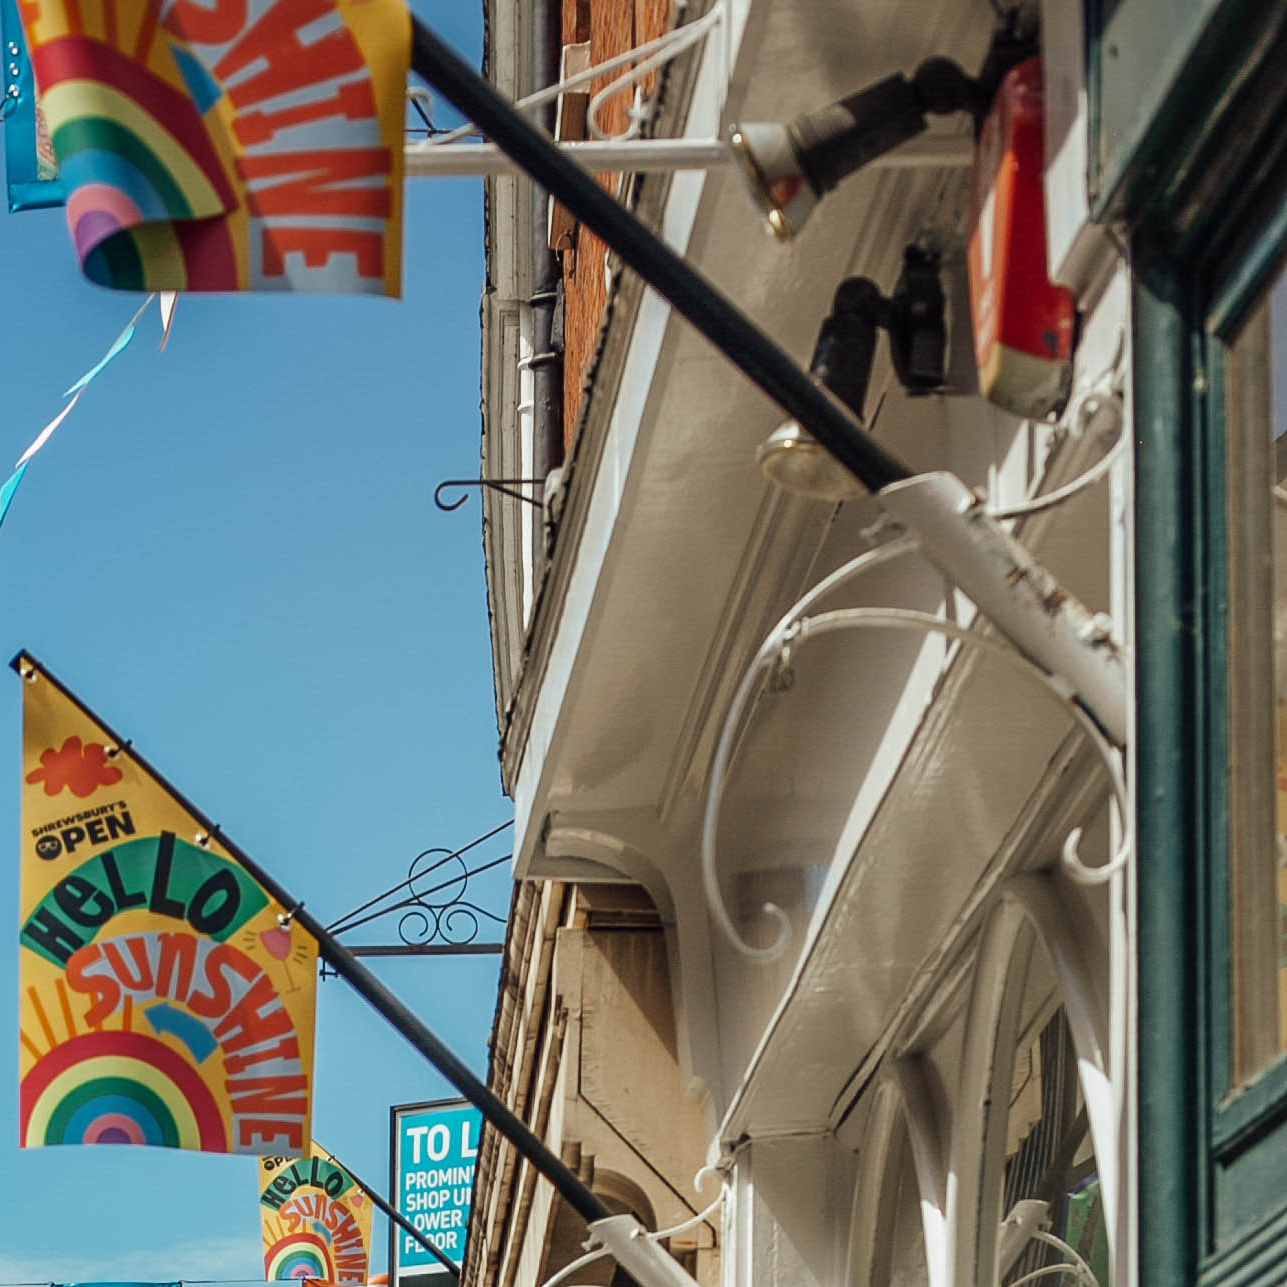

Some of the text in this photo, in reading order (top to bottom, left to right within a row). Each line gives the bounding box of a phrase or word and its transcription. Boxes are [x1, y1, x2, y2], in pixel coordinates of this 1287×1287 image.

[32, 801, 127, 838] SHREWSBURY'S
[35, 810, 136, 861] OPEN
[406, 1123, 451, 1165] TO
[405, 1164, 475, 1191] PROMIN
[405, 1189, 450, 1212] SHOP
